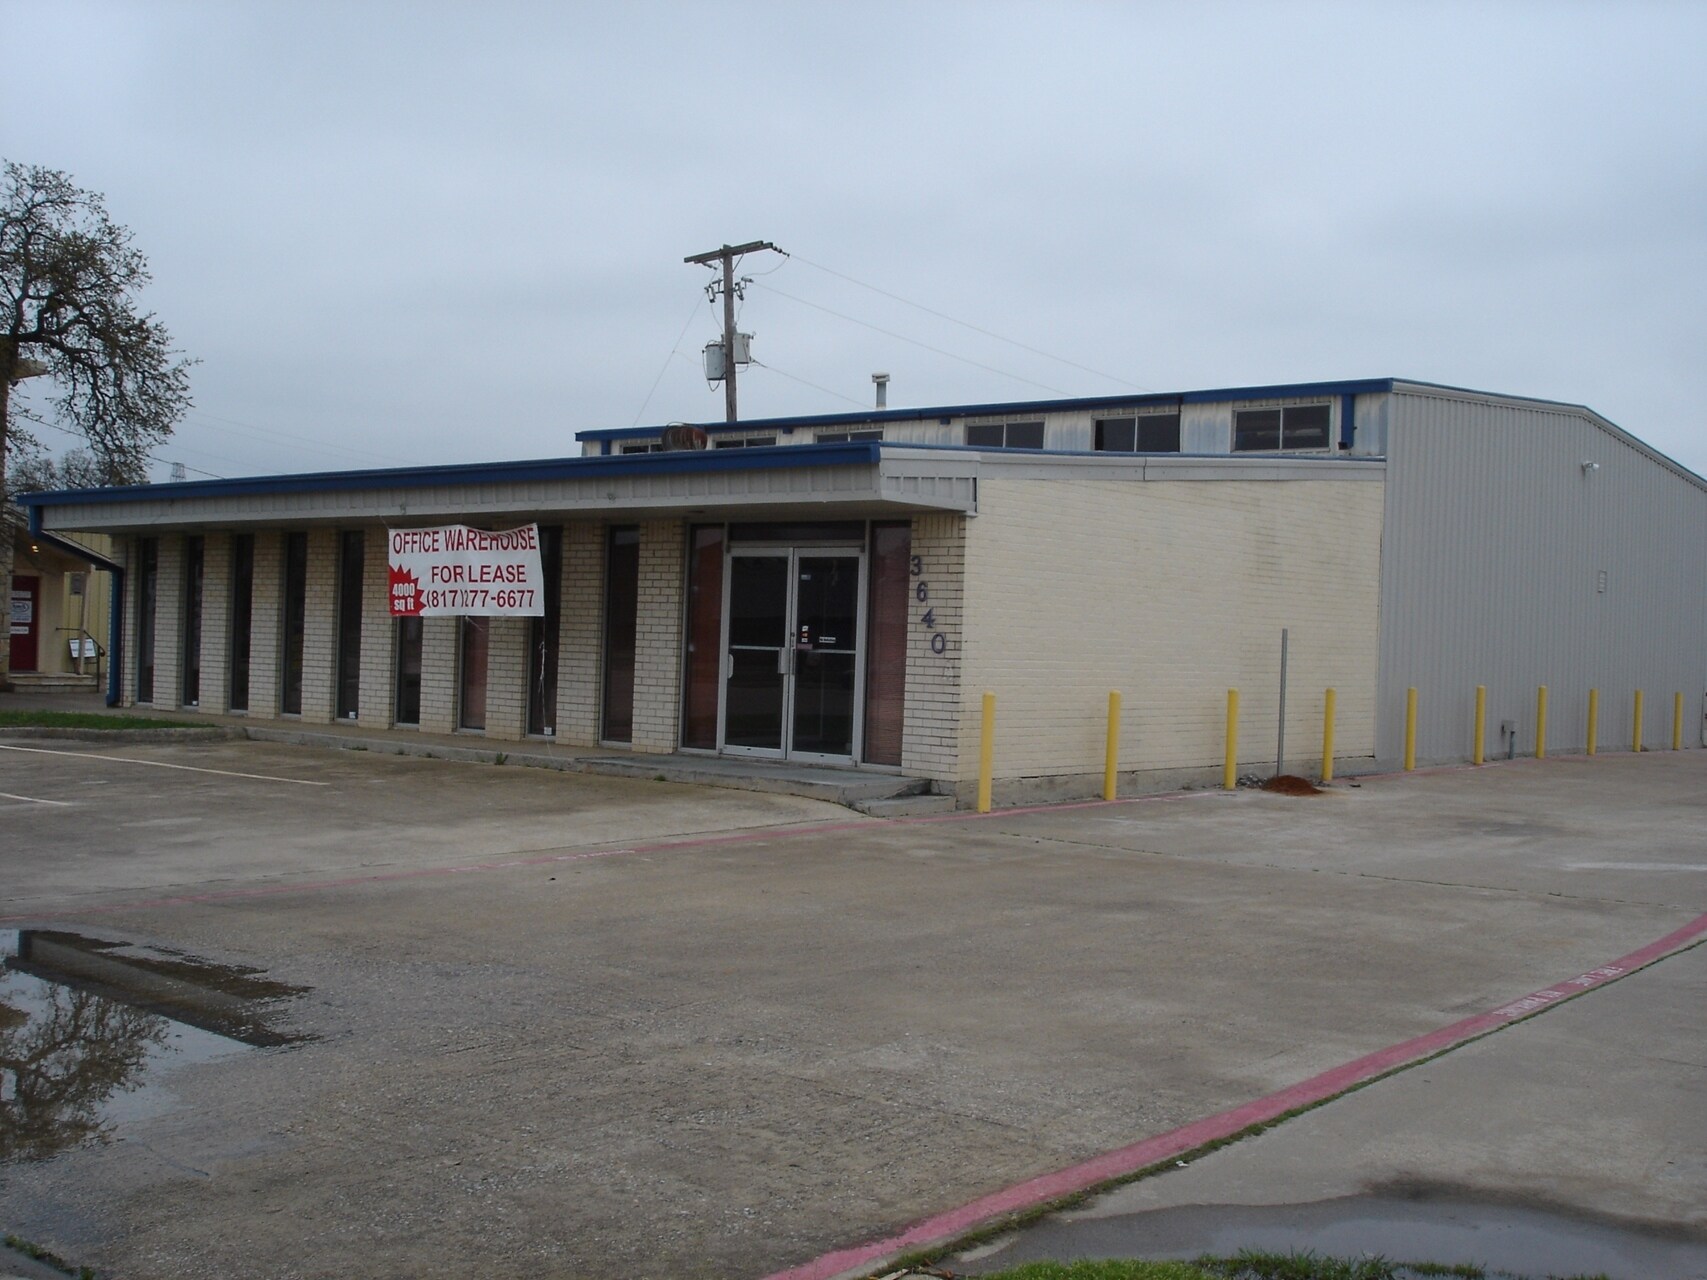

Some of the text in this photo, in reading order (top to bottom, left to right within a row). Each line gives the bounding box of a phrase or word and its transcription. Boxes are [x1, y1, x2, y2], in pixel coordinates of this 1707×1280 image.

[392, 527, 537, 554] OFFICE WAREHOUSE
[431, 564, 527, 584] FOR LEASE
[392, 582, 416, 597] 4000
[426, 589, 535, 608] (817)277-6677
[393, 597, 415, 612] sq ft
